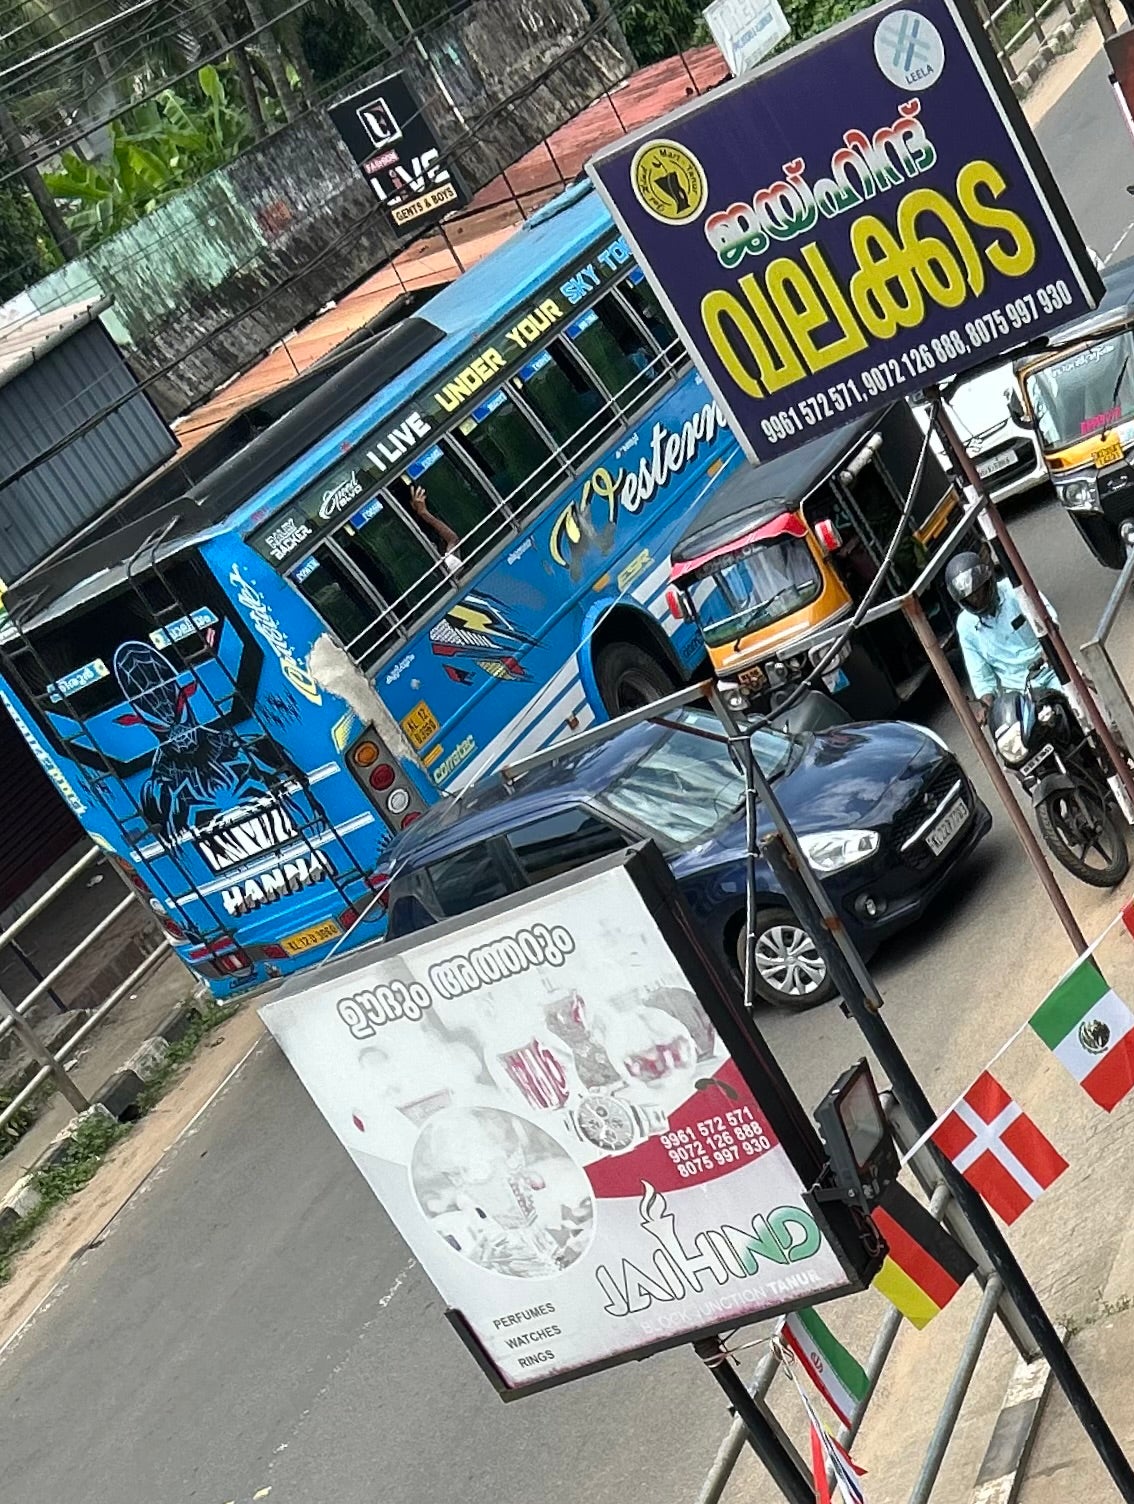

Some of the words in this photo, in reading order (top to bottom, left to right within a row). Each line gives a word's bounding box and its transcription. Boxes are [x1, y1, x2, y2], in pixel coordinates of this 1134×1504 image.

[905, 64, 935, 86] LEELA
[659, 149, 681, 162] Mart
[686, 164, 698, 195] Tanur
[704, 98, 937, 269] ജയ്ഹിന്ദ്
[396, 200, 423, 222] GENTS
[425, 197, 432, 208] &
[430, 187, 454, 206] BOYS
[701, 160, 1036, 400] വലക്കട
[366, 451, 386, 472] I
[376, 410, 432, 463] LIVE
[434, 347, 507, 412] UNDER
[505, 298, 563, 349] YOUR
[560, 264, 600, 304] SKY
[761, 406, 804, 443] 9961
[798, 392, 835, 426] 572
[861, 358, 906, 396] 9072
[901, 343, 935, 377] 126
[964, 309, 1010, 348] 8075
[1005, 293, 1039, 329] 997
[1036, 279, 1073, 315] 930
[429, 923, 575, 1000] അത്തറും
[660, 1125, 695, 1150] 9961
[697, 1116, 727, 1140] 572
[727, 1105, 755, 1132] 571
[669, 1140, 703, 1165] 9072
[705, 1131, 734, 1156] 126
[735, 1121, 764, 1146] 888
[677, 1154, 710, 1179] 8075
[711, 1145, 741, 1170] 997
[742, 1135, 771, 1161] 930
[493, 1302, 556, 1330] PERFUMES
[641, 1310, 693, 1334] BLOCK
[692, 1287, 768, 1321] JUNCTION
[766, 1268, 823, 1294] TANUR
[505, 1325, 562, 1350] WATCHES
[518, 1349, 555, 1370] RINGS
